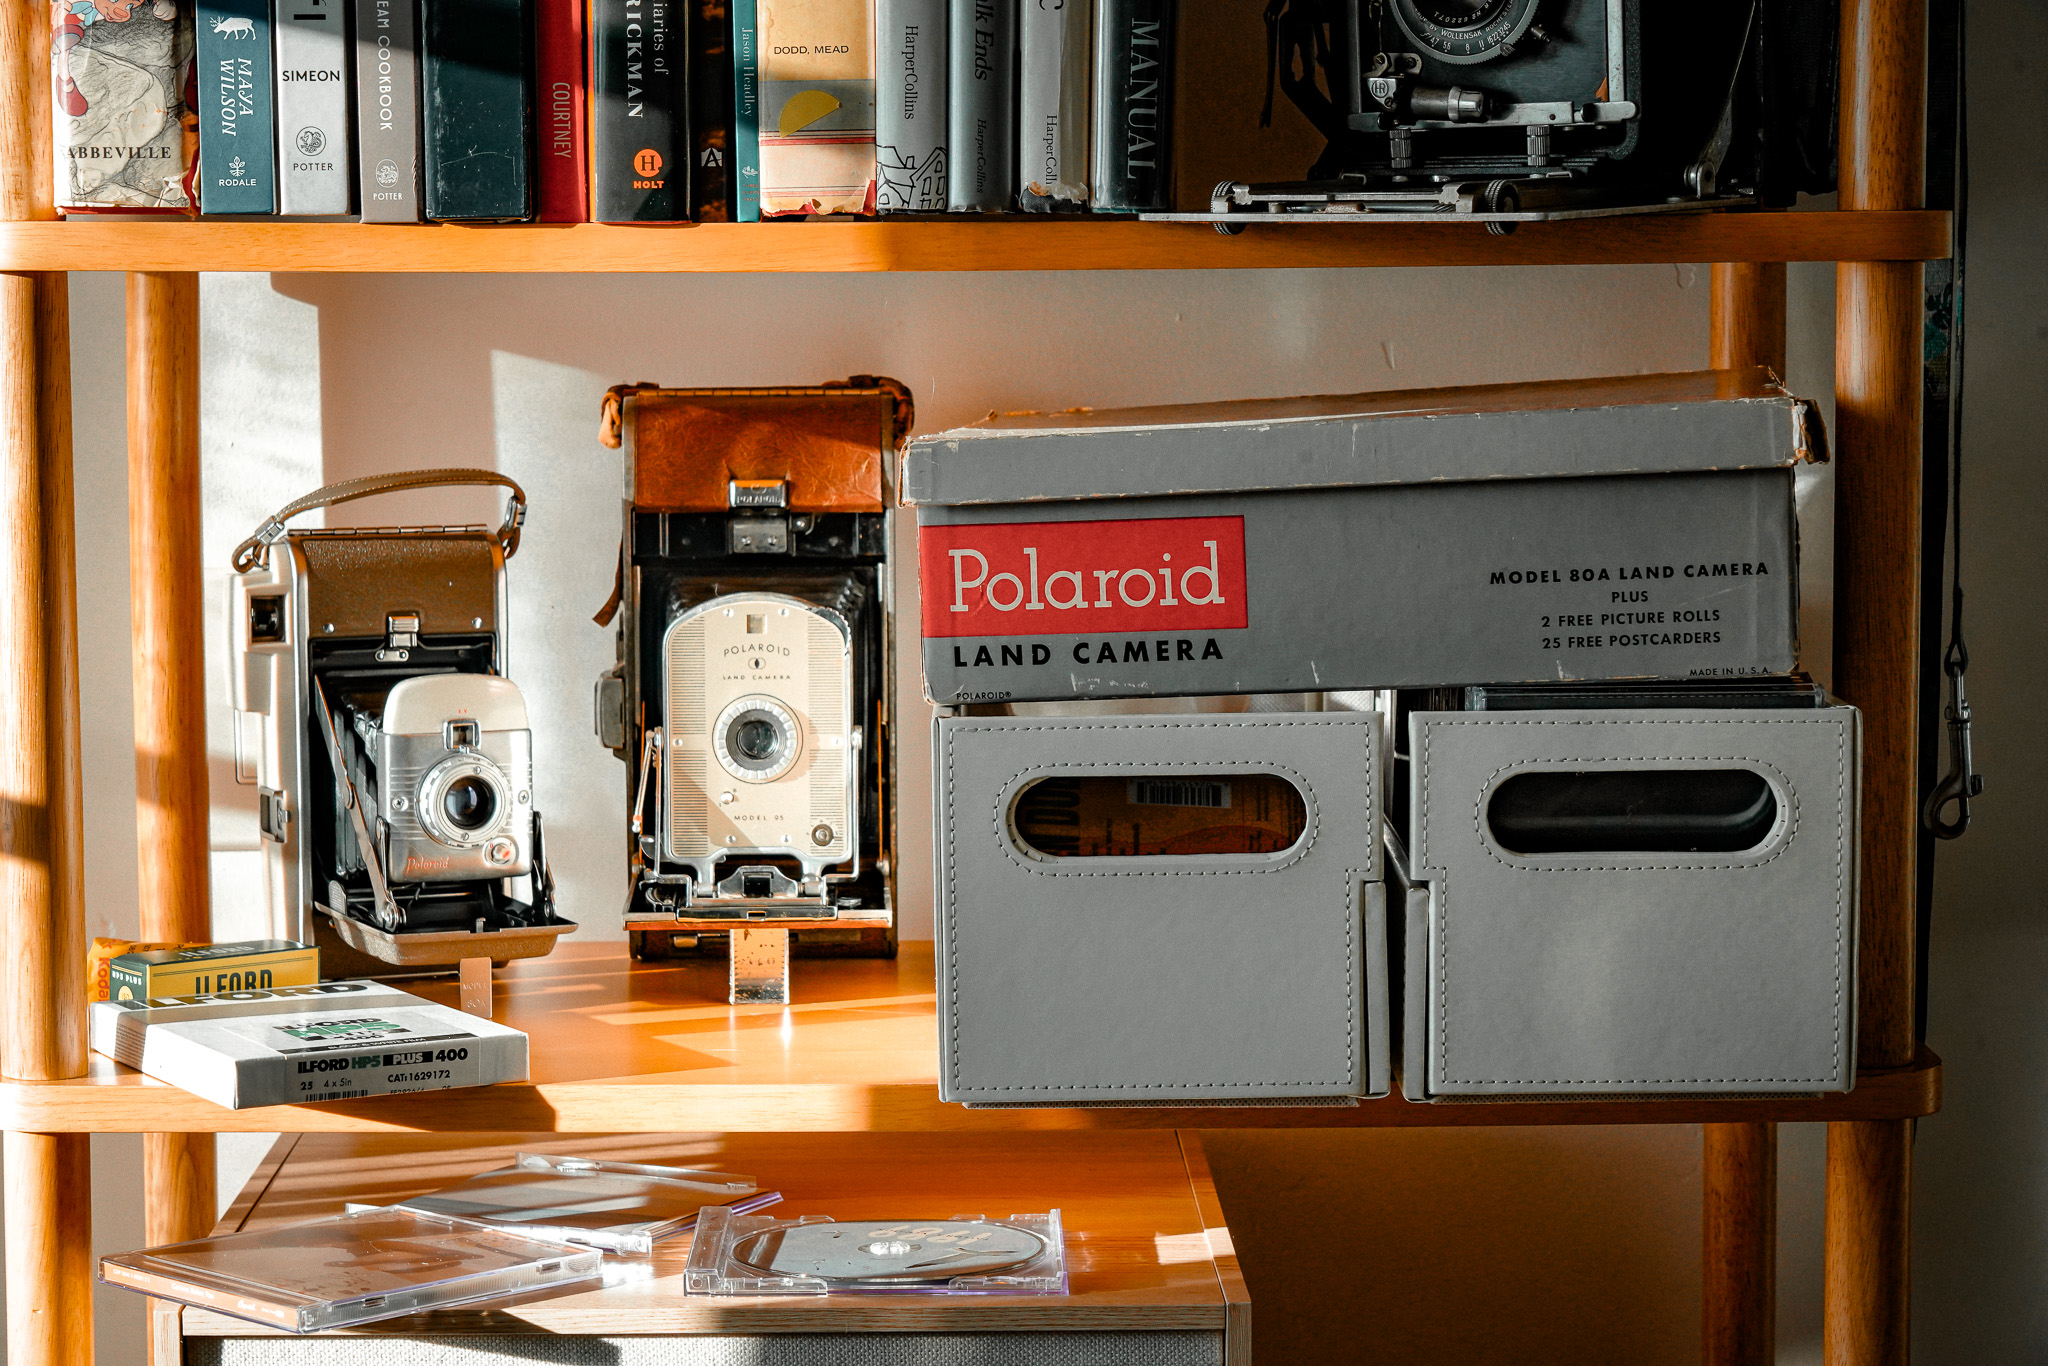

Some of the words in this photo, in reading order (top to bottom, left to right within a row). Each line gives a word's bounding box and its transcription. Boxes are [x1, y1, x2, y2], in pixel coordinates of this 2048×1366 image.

[975, 0, 995, 23] lk
[1441, 28, 1482, 40] WOLLENSAK
[741, 27, 753, 61] Jason
[774, 46, 809, 55] DODD,
[815, 45, 849, 53] MEAD
[974, 28, 994, 80] Ends
[653, 57, 670, 75] of
[901, 25, 918, 120] HarperCollins
[282, 70, 341, 82] SIMEON
[377, 35, 393, 131] COOKBOOK
[237, 57, 254, 116] MAYA
[741, 66, 755, 116] Headley
[220, 59, 237, 137] WILSON
[1126, 18, 1160, 179] MANUAL
[552, 82, 572, 158] COURTNEY
[66, 146, 172, 159] ABBEVILLE
[974, 118, 987, 193] HarperCollins
[293, 163, 334, 171] POTTER
[640, 155, 656, 171] H
[218, 178, 257, 187] RODALE
[633, 180, 665, 189] HOLT
[373, 192, 403, 201] POTTER
[948, 540, 1226, 612] Polaroid
[1489, 568, 1562, 585] MODEL
[1569, 567, 1611, 582] 80A
[1619, 565, 1675, 580] LAND
[1683, 562, 1769, 578] CAMERA
[1611, 590, 1650, 603] PLUS
[1541, 615, 1551, 628] 2
[1558, 614, 1594, 627] FREE
[1601, 611, 1665, 626] PICTURE
[1673, 609, 1720, 623] ROLLS
[1542, 637, 1562, 649] 25
[1568, 635, 1603, 648] FREE
[1609, 631, 1721, 647] POSTCARDERS
[724, 643, 790, 658] POLAROID
[953, 643, 1052, 668] LAND
[1072, 638, 1224, 665] CAMERA
[1689, 667, 1718, 677] MADE
[1722, 667, 1734, 676] IN
[407, 857, 450, 874] Polaroid
[97, 957, 111, 1002] Koda
[125, 974, 142, 986] PLUS
[195, 969, 273, 999] ILFORD
[297, 1058, 350, 1074] ILFORD
[351, 1055, 381, 1069] HP5
[392, 1052, 423, 1065] PLUS
[435, 1048, 468, 1062] 400
[300, 1081, 313, 1091] 25
[323, 1080, 330, 1088] 4
[339, 1078, 352, 1087] 5in
